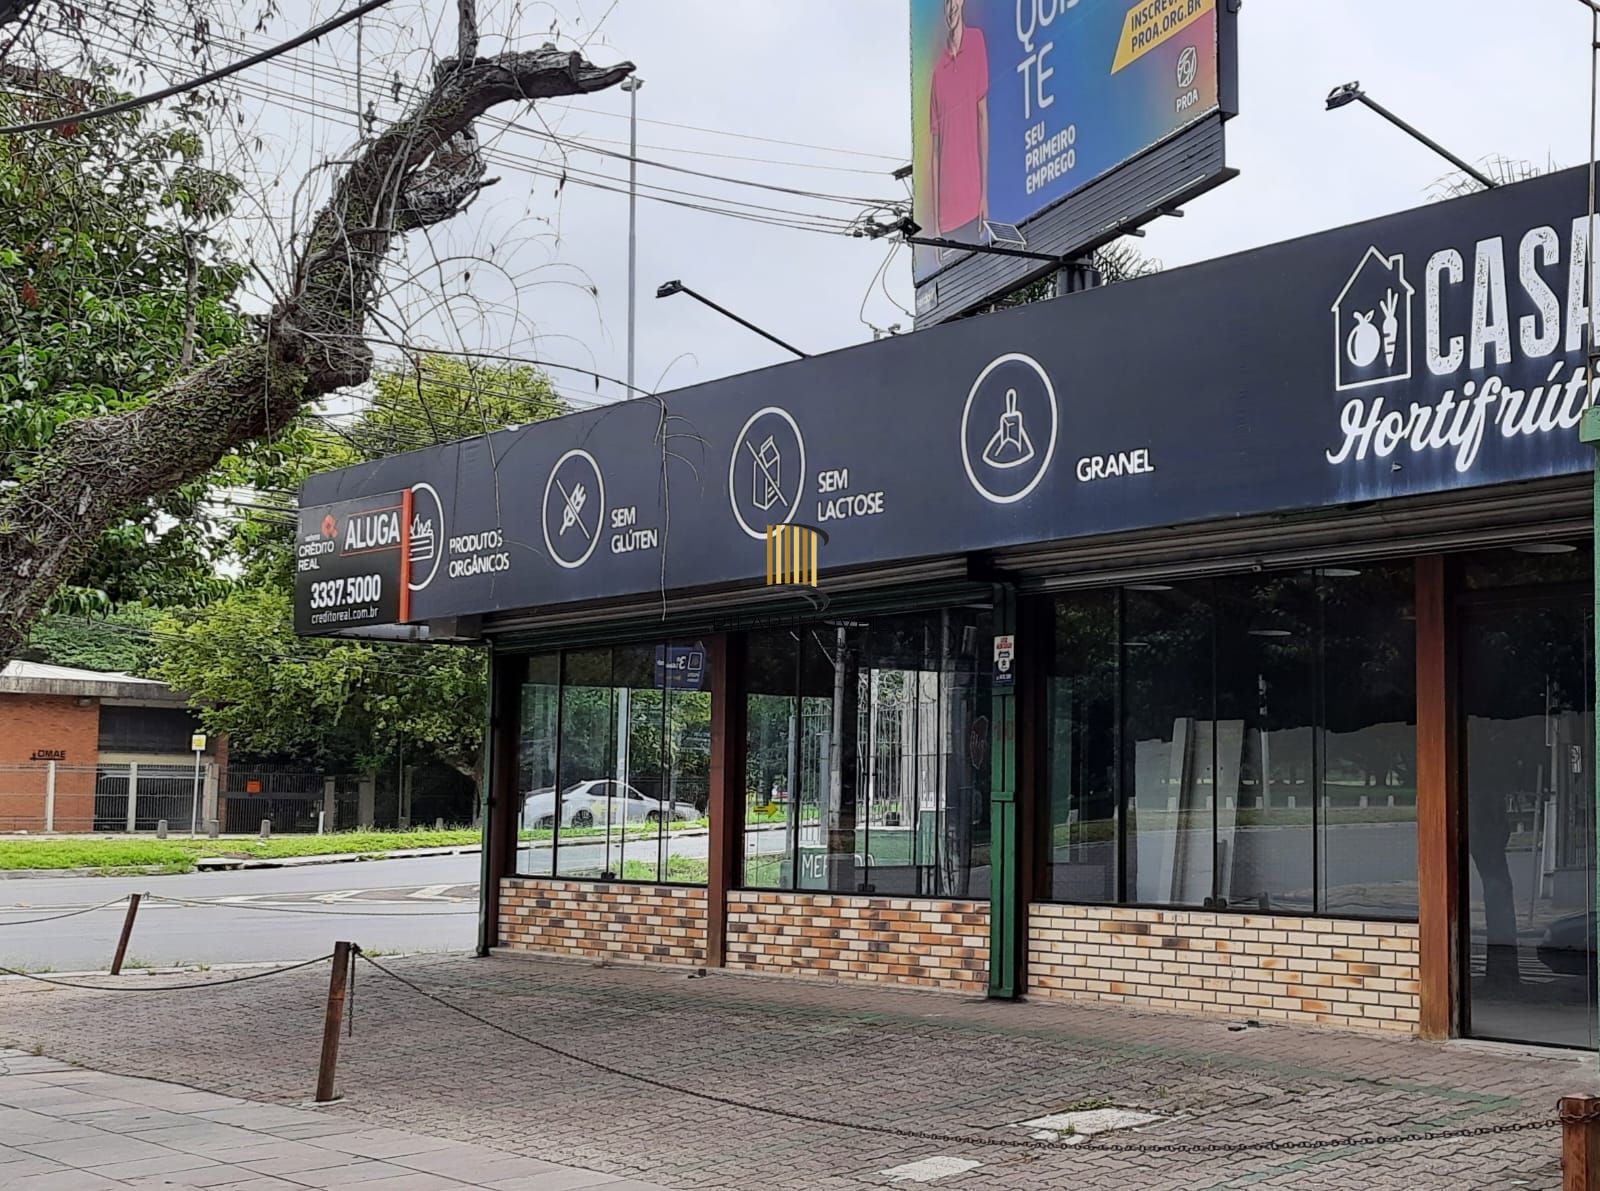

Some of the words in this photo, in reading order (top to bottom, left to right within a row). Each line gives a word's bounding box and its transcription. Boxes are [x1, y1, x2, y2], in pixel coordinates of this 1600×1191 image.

[1131, 0, 1178, 32] INSCRE
[1131, 0, 1202, 53] PROA.ORG.BR
[1017, 41, 1055, 119] TE
[1176, 89, 1199, 113] PROA
[1025, 120, 1045, 150] SEU
[1025, 124, 1076, 173] PRIMEIRO
[1026, 148, 1076, 195] EMPREGO
[1425, 213, 1600, 376] CASA
[1076, 448, 1154, 482] GRANEL
[818, 468, 848, 493] SEM
[611, 506, 636, 528] SEM
[818, 491, 884, 522] LACTOSE
[345, 512, 400, 550] ALUGA
[450, 529, 503, 554] PRODUTOS
[611, 528, 658, 554] GLÚTEN
[299, 540, 335, 557] CRÉDITO
[298, 558, 320, 572] REAL
[449, 552, 510, 578] ORGÂNICOS
[310, 574, 381, 609] 3337.5000
[312, 606, 379, 624] creditoreal.com.br
